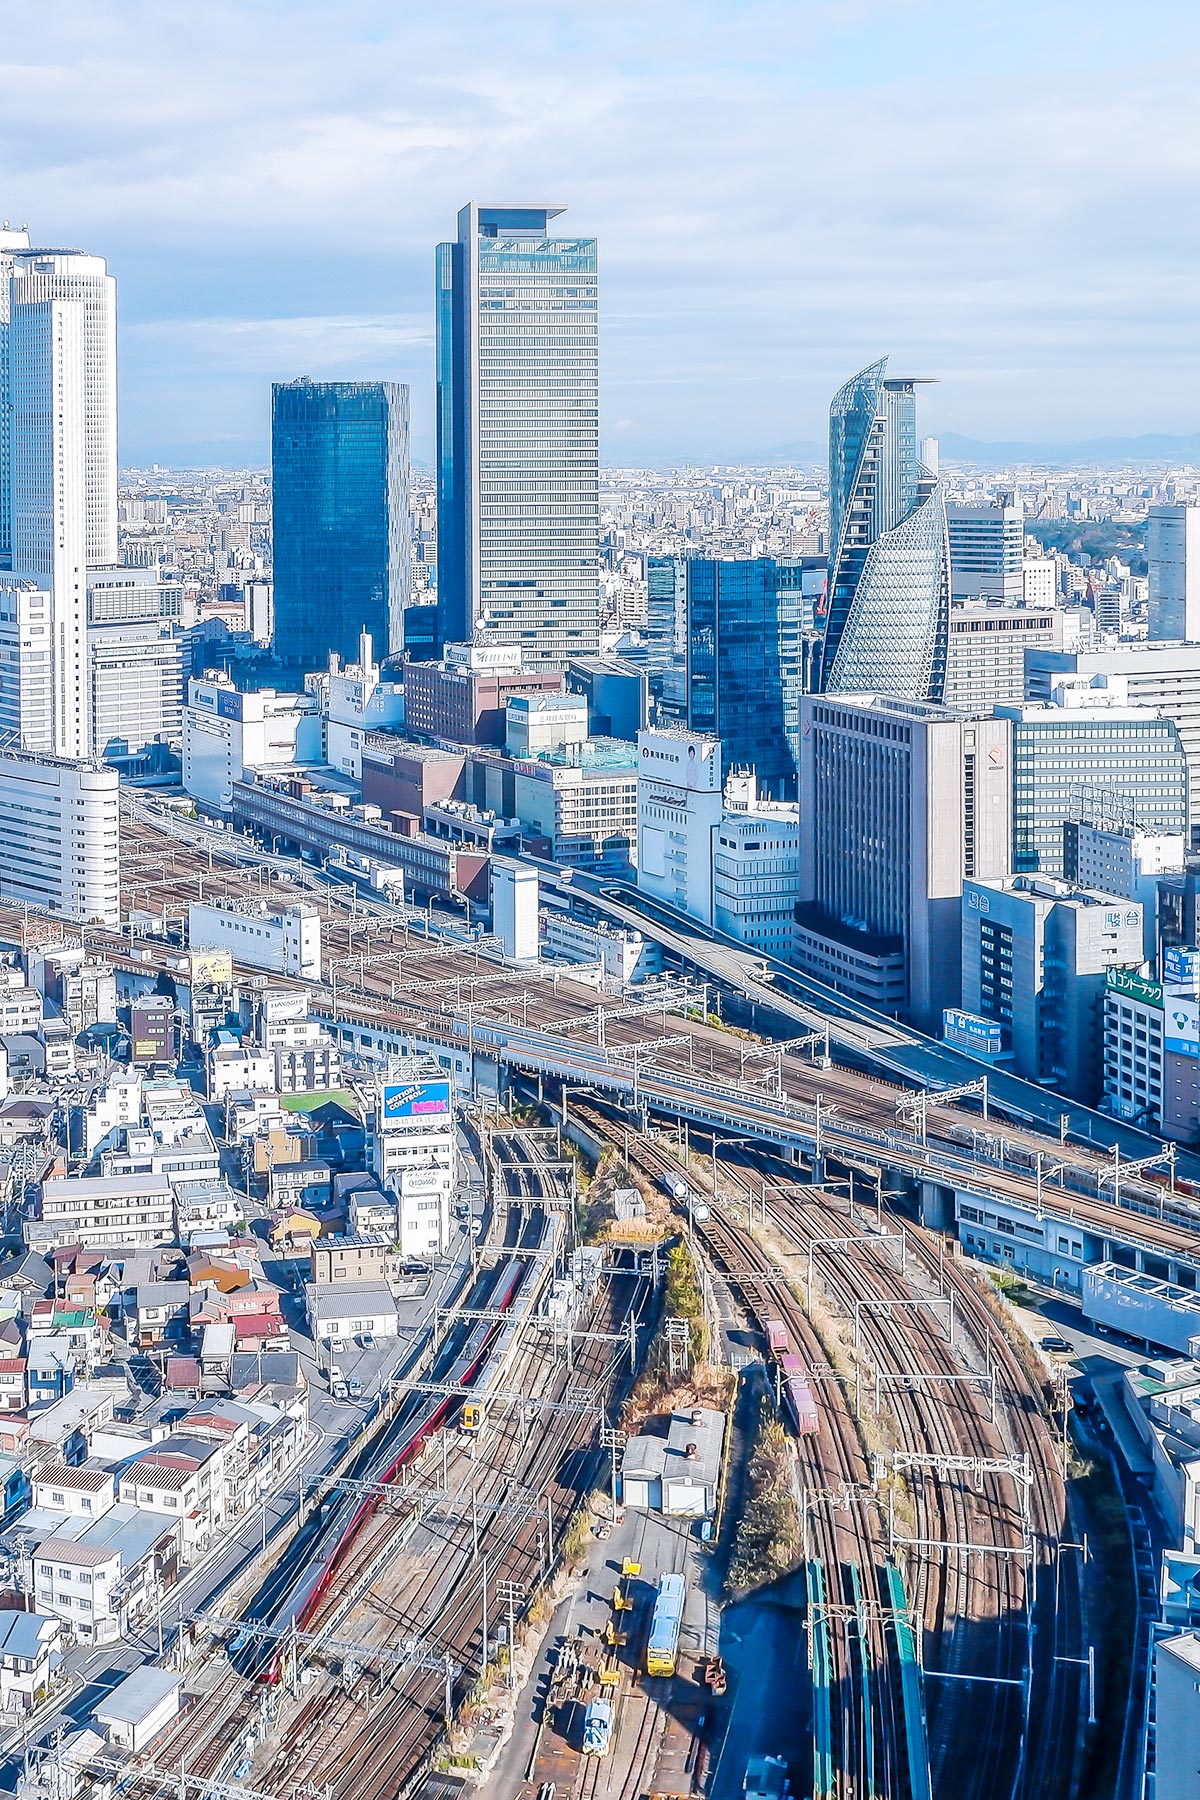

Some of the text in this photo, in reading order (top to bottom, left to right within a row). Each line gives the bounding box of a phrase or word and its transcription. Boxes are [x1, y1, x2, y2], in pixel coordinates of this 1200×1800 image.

[1105, 910, 1140, 929] 駿台
[1117, 973, 1162, 1001] コンドーテック
[386, 1086, 417, 1106] MOTION
[412, 1099, 448, 1115] NSK
